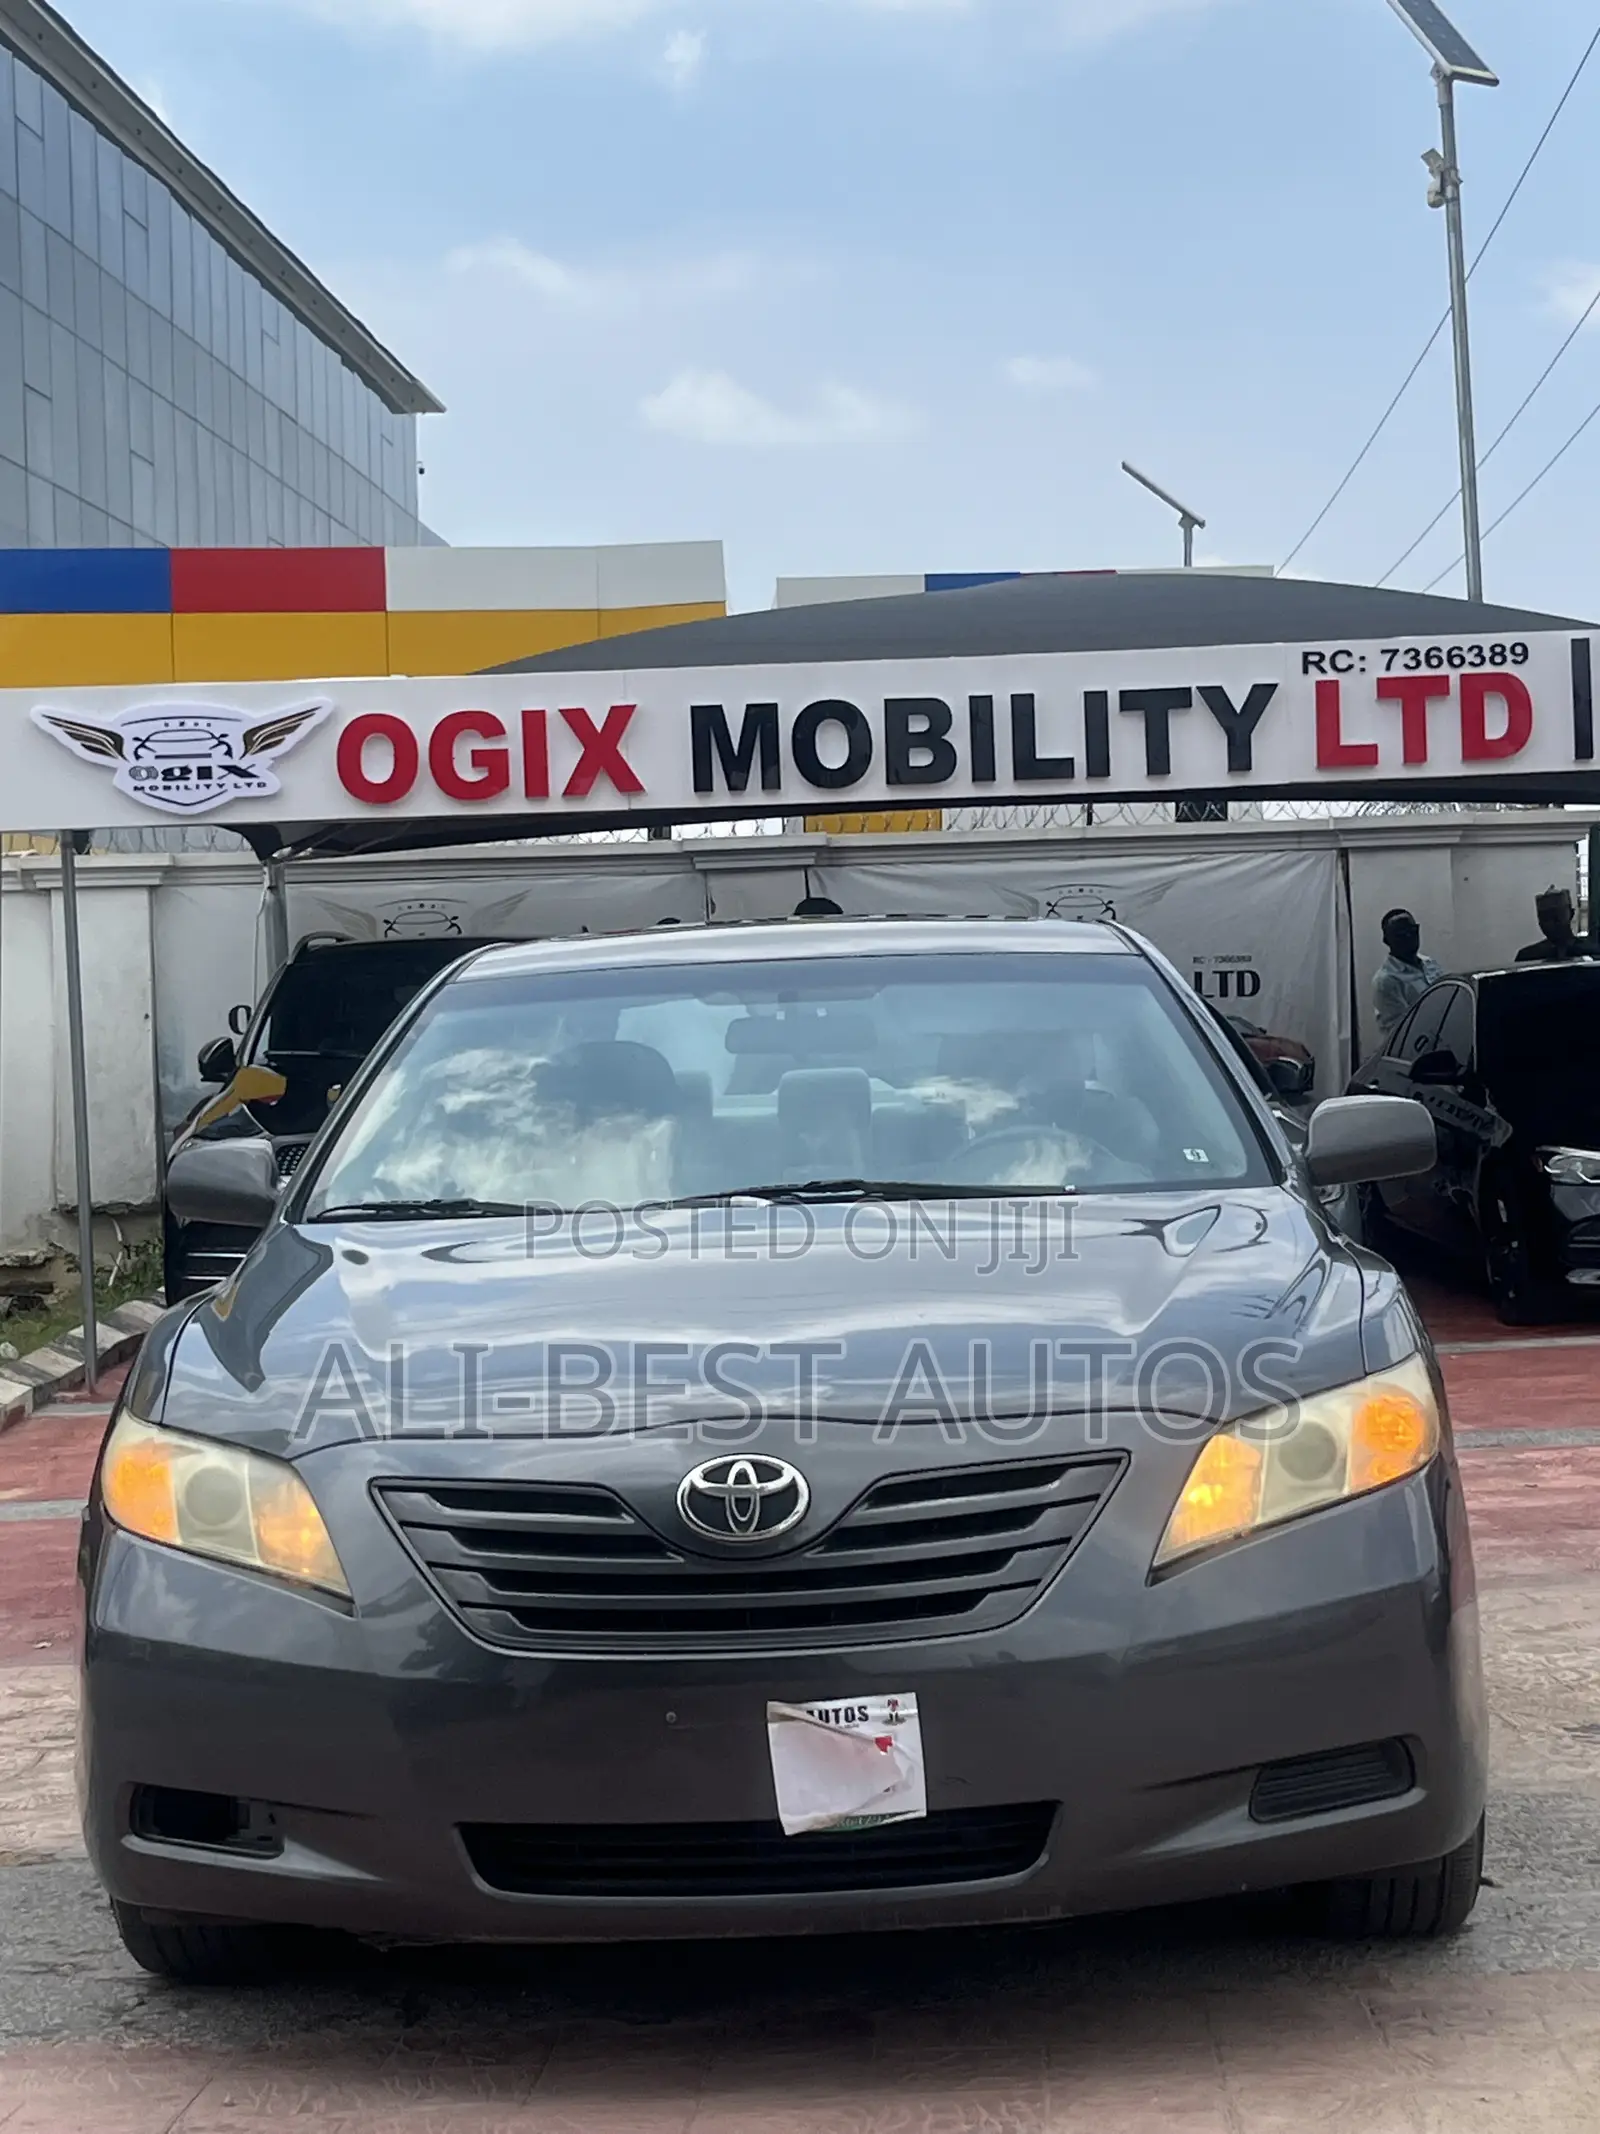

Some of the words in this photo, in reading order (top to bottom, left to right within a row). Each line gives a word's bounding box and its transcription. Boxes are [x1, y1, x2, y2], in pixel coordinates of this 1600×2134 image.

[1302, 650, 1367, 675] RC:
[1380, 642, 1529, 671] 7366389
[336, 703, 646, 804] OGIX
[690, 683, 1279, 793] MOBILITY
[1315, 672, 1533, 769] LTD
[133, 782, 226, 792] MOBILITY
[233, 781, 267, 789] LTD
[1194, 970, 1261, 998] LTD
